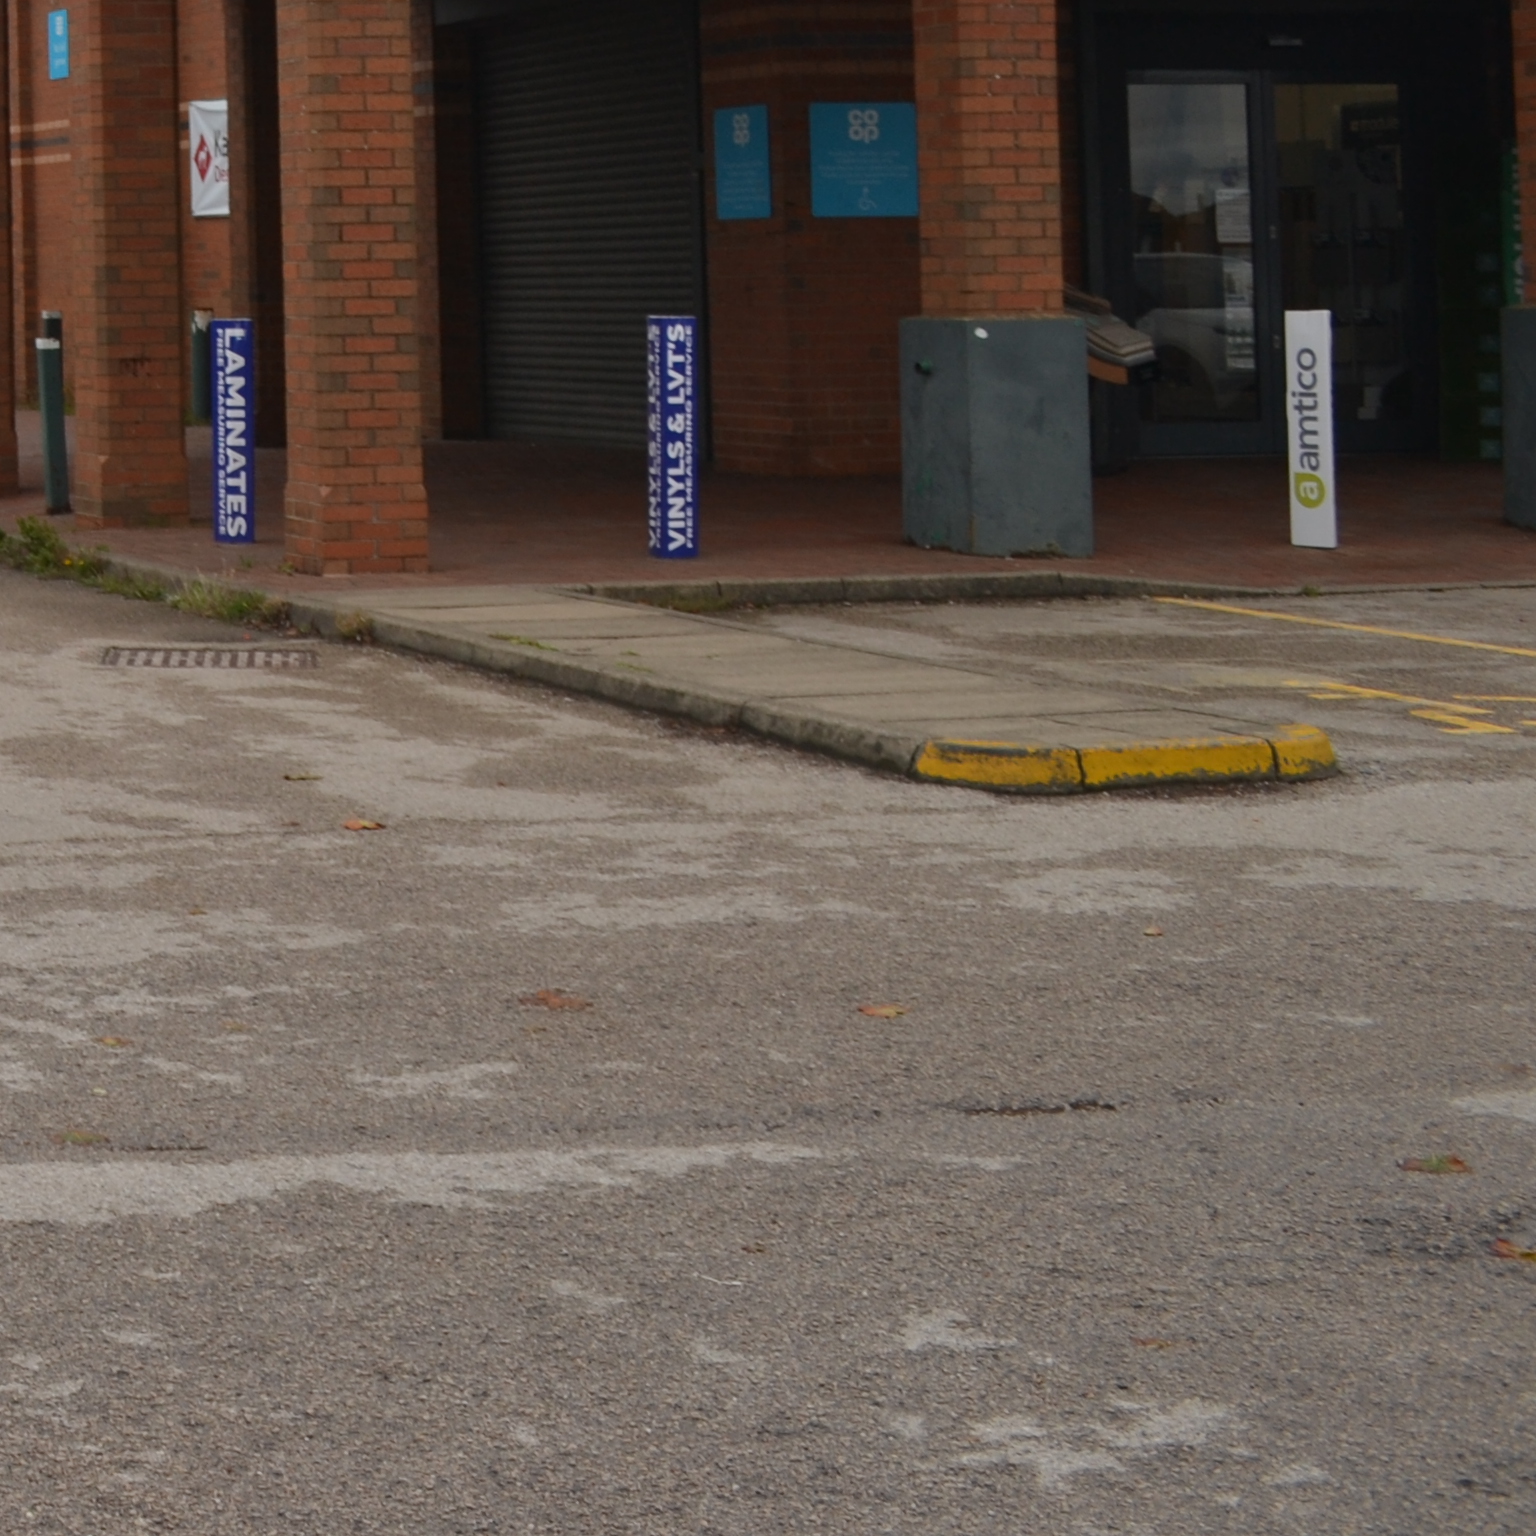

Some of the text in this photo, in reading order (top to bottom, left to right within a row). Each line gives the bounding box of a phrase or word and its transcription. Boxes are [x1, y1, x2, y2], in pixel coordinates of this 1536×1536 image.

[216, 328, 226, 536] FREE MEASURING SERVICE
[224, 328, 248, 538] LAMINATES
[666, 324, 687, 551] VINYLS & LVT'S
[685, 325, 694, 549] FREE MEASURING SERVICE
[1292, 347, 1320, 472] amtico
